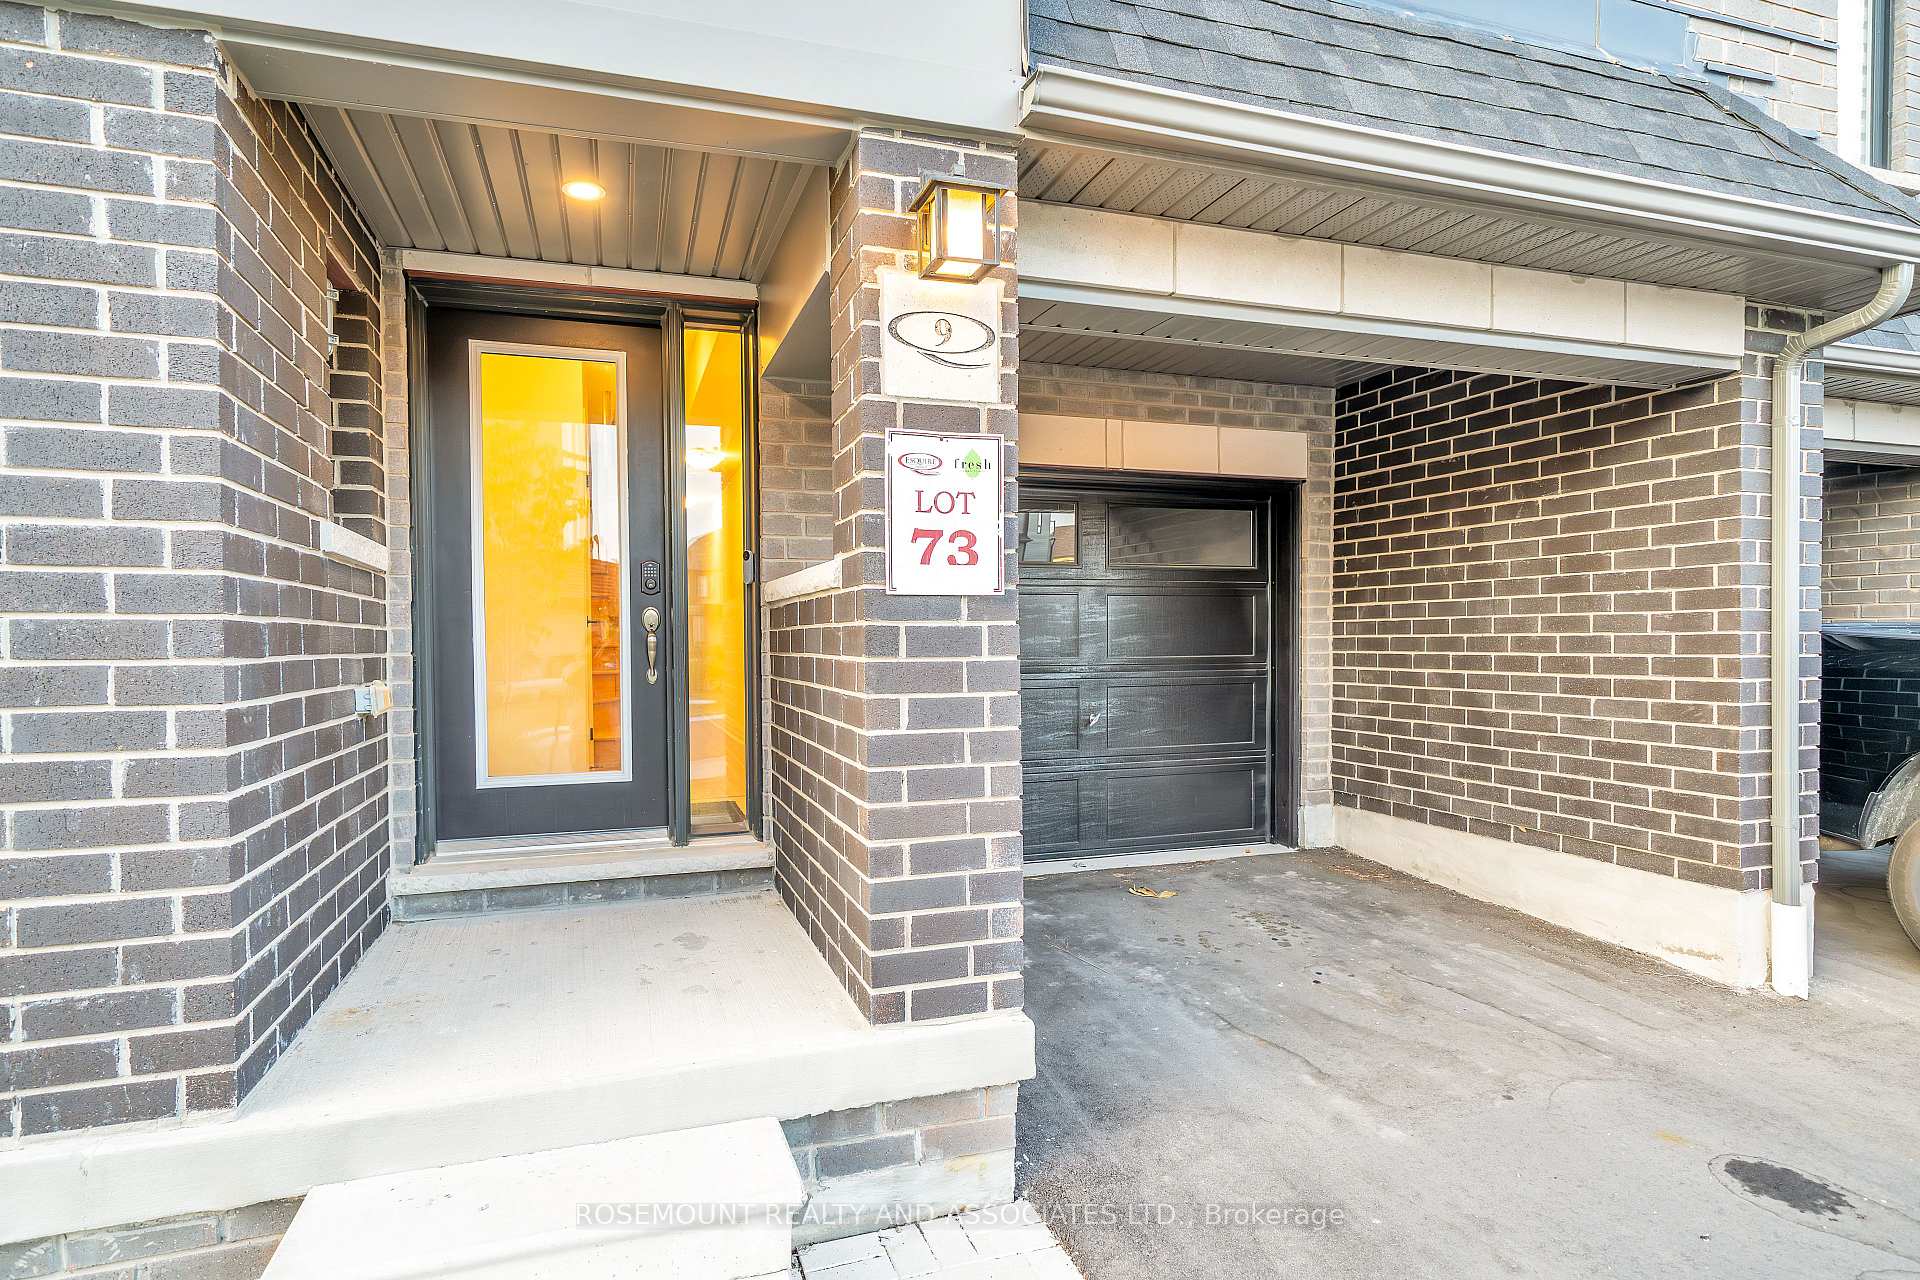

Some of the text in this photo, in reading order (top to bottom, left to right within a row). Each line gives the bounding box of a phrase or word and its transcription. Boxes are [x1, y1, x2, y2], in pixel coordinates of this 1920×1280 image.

[934, 318, 953, 347] 9
[914, 490, 976, 515] LOT
[910, 527, 979, 566] 73
